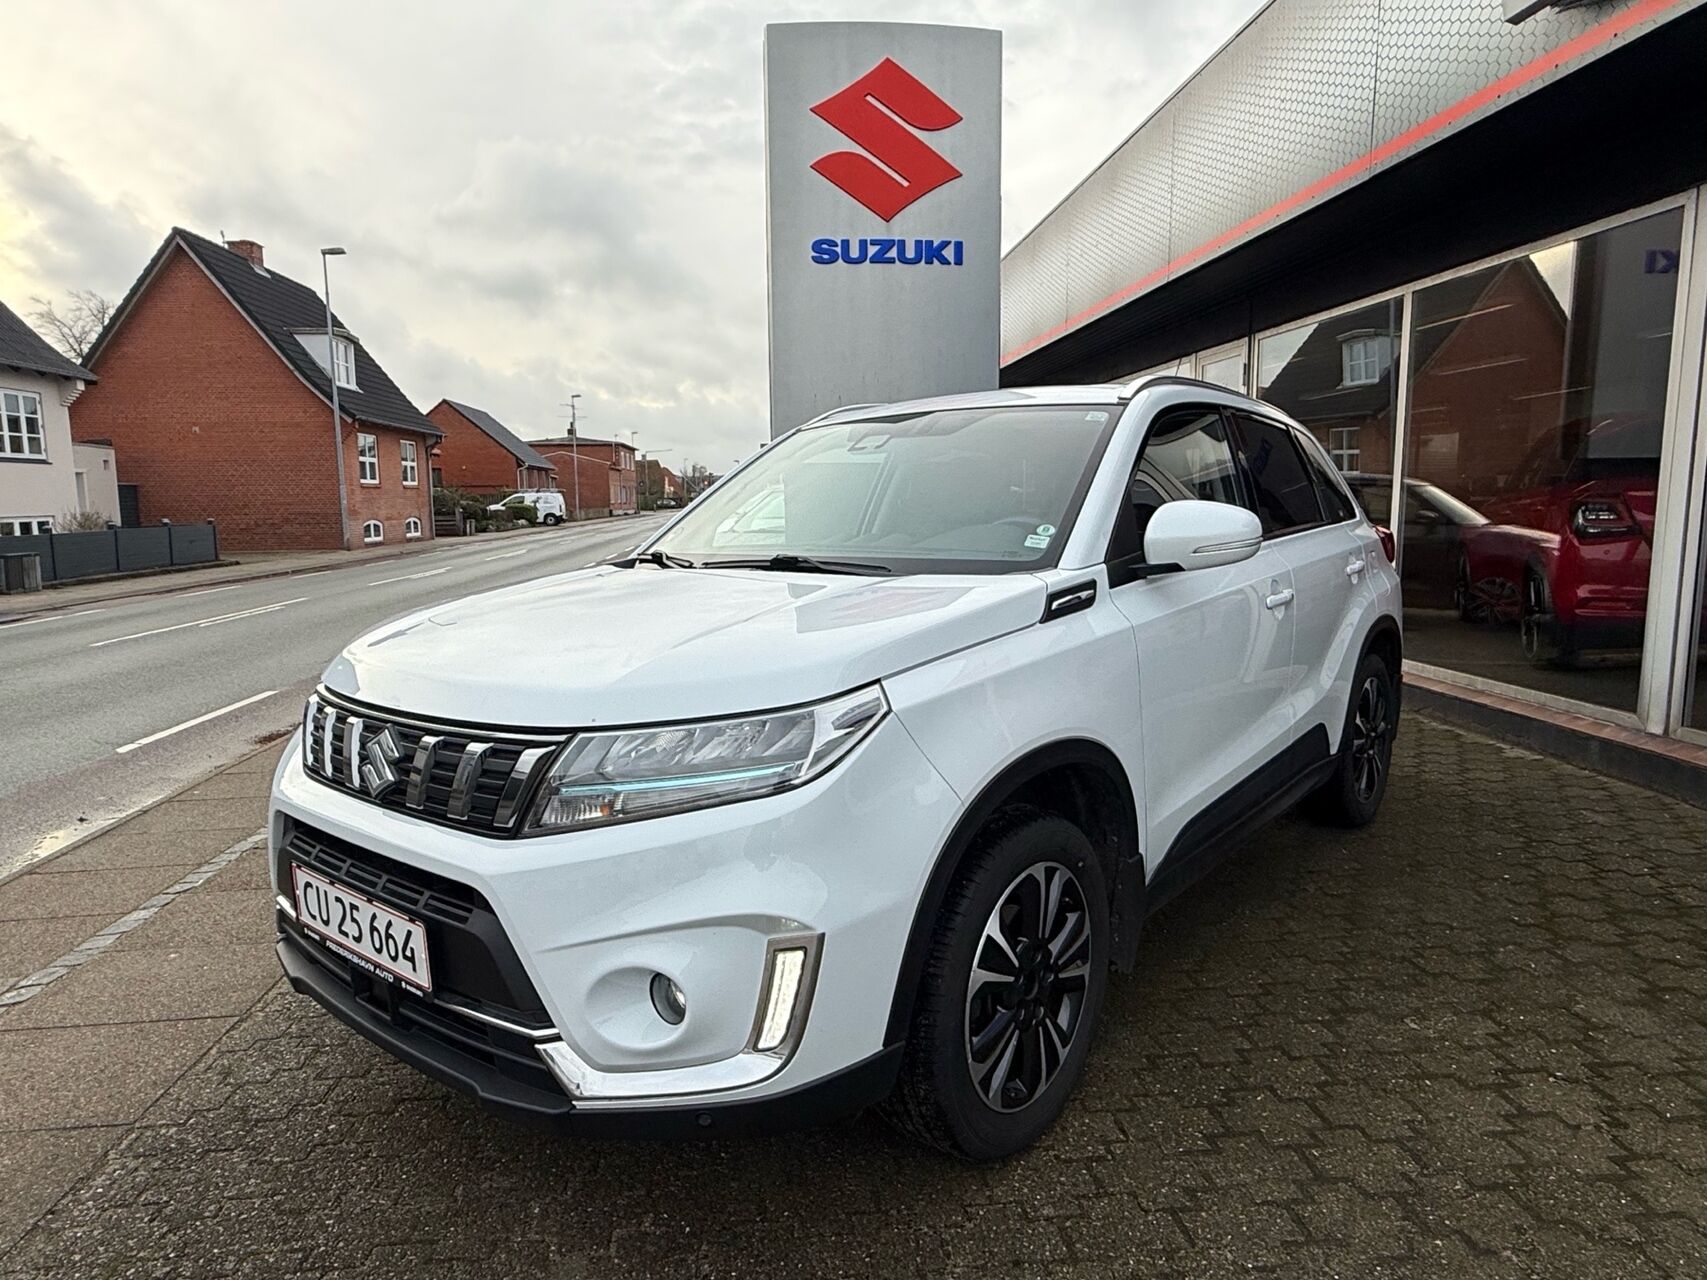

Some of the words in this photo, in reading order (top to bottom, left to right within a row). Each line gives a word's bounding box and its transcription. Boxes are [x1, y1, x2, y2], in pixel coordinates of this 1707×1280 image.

[811, 238, 963, 266] SUZUKI
[303, 880, 330, 927] CU
[334, 895, 363, 944] 25
[369, 911, 417, 973] 664
[375, 969, 394, 983] AUTO
